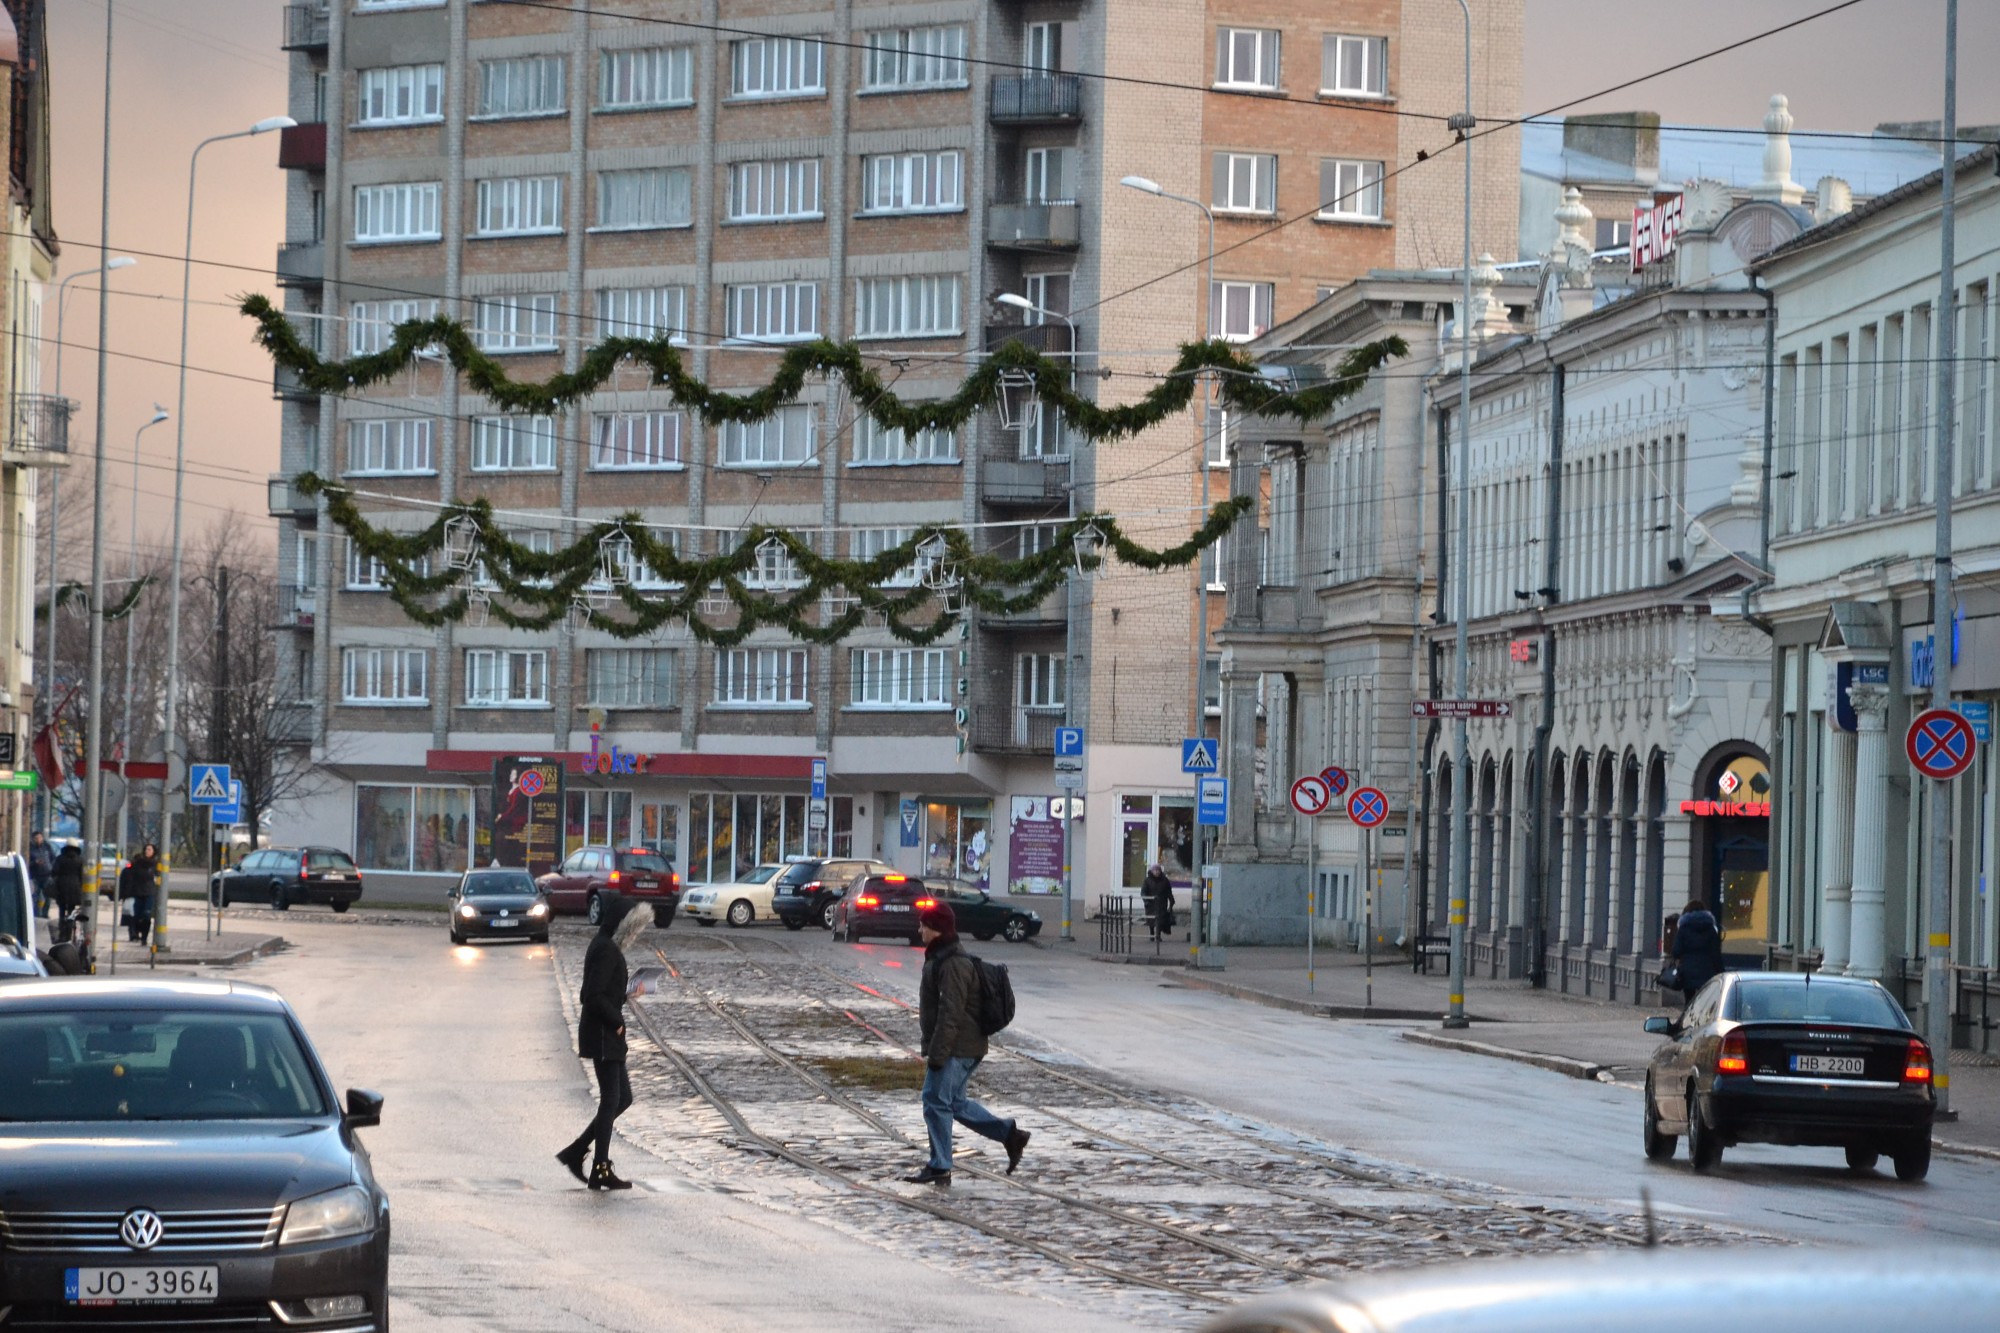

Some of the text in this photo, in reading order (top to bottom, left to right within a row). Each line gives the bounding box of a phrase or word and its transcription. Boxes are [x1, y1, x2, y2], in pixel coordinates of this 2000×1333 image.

[1862, 667, 1885, 678] LSC
[581, 722, 649, 775] Joker
[1062, 730, 1079, 753] P
[1680, 800, 1771, 817] FENIKSS
[1808, 1032, 1851, 1040] VAUXHALL
[1799, 1057, 1863, 1073] HB-2200
[66, 1285, 78, 1295] LV
[86, 1269, 214, 1296] JO-3964
